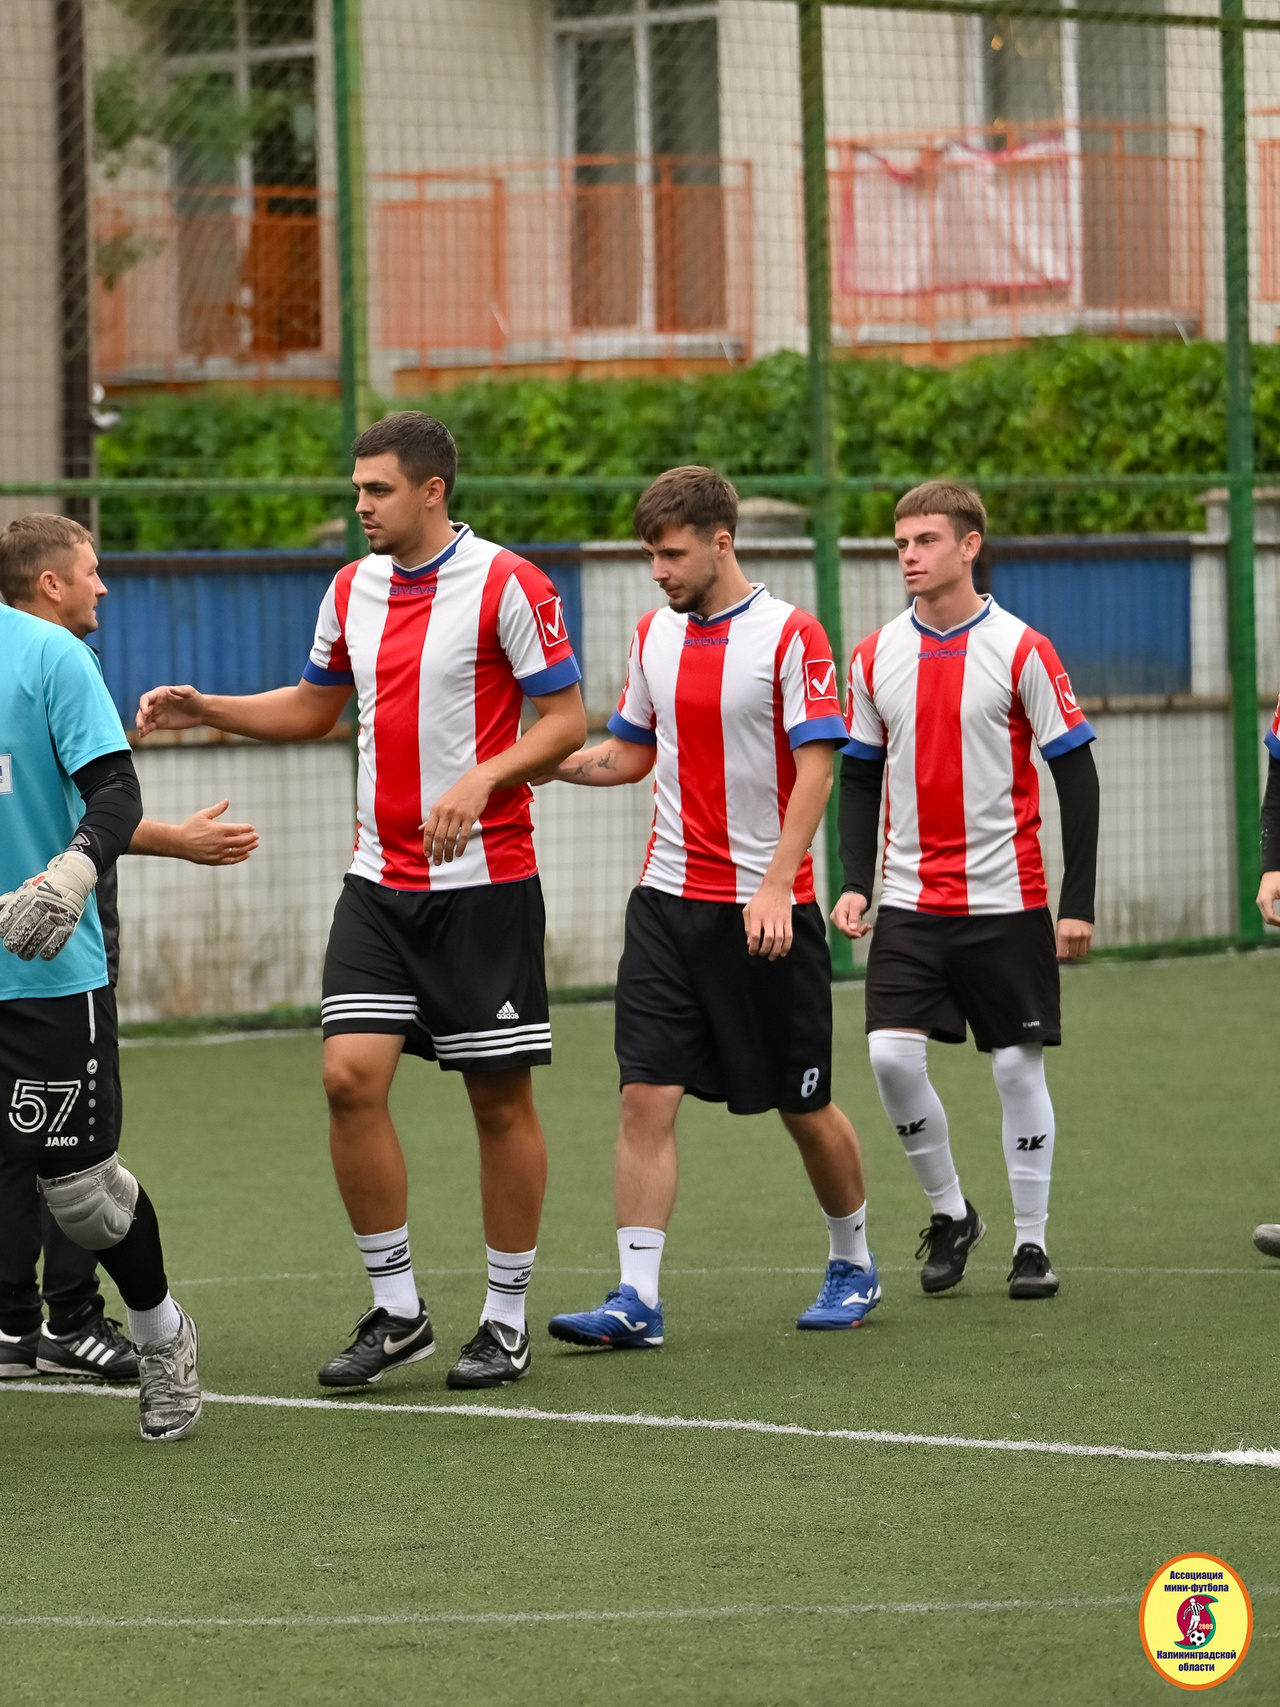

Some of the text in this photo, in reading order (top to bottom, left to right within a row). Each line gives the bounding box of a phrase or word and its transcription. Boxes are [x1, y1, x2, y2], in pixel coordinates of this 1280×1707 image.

[389, 586, 437, 596] GIVOVA
[683, 637, 729, 647] GIVOVA
[918, 650, 967, 660] GIVOVA
[496, 1012, 520, 1020] adidas
[800, 1066, 820, 1099] 8
[8, 1078, 82, 1134] 57
[896, 1117, 927, 1137] 2K
[45, 1136, 79, 1147] JAKO
[1016, 1134, 1047, 1151] 2K
